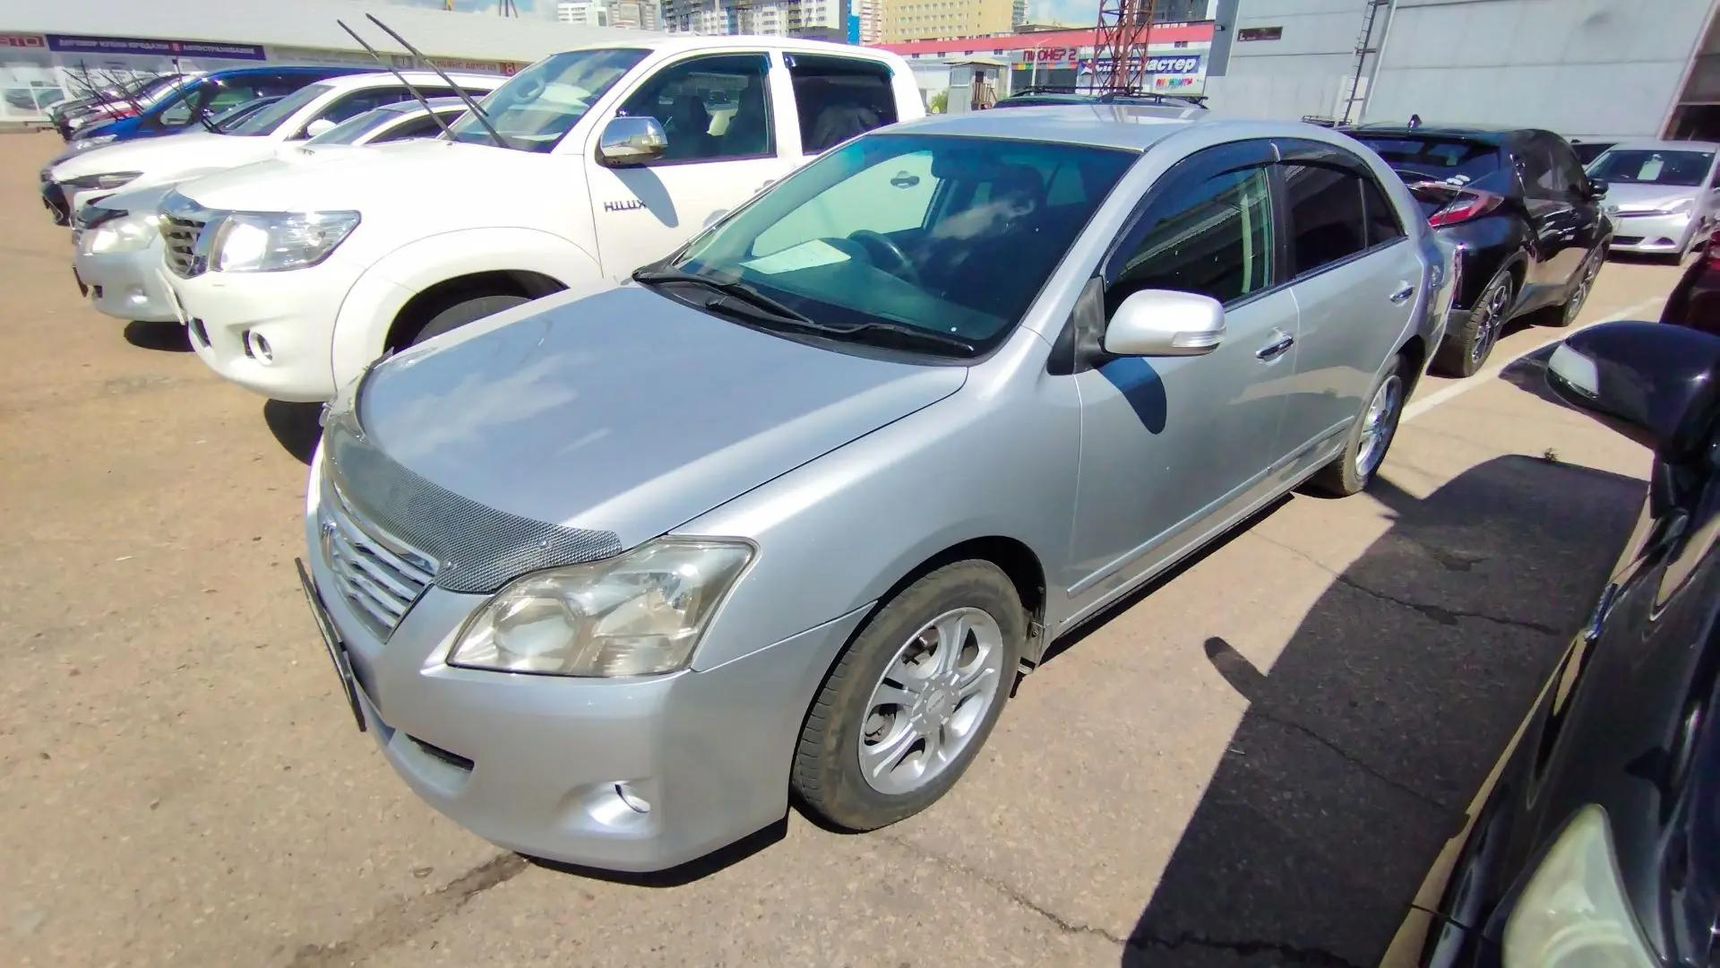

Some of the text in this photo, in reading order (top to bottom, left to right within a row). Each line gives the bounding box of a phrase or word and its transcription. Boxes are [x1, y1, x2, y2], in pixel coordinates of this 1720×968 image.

[1068, 49, 1077, 61] 2
[1095, 58, 1197, 74] сптастер
[603, 200, 647, 212] HILUX
